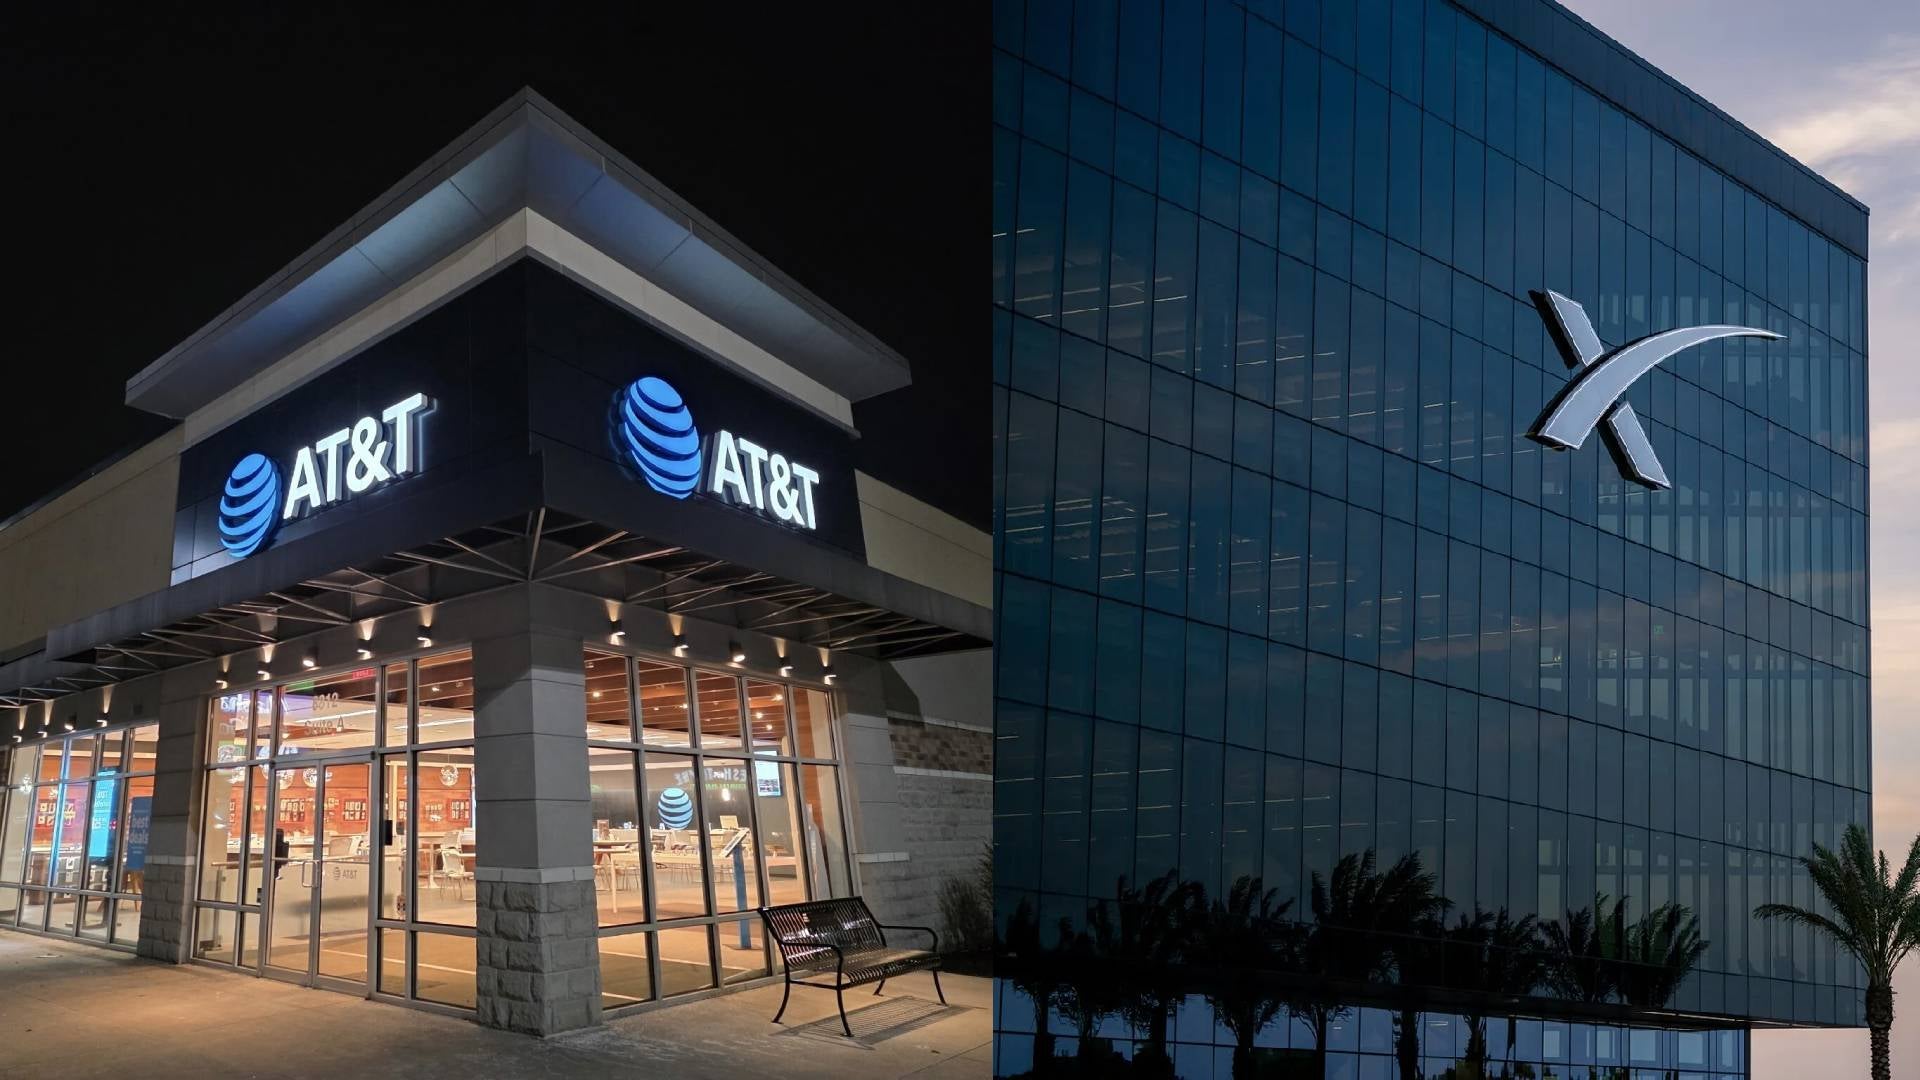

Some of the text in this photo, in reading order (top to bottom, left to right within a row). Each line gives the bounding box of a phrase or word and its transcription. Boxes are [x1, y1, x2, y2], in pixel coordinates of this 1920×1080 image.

[283, 392, 426, 520] AT&T
[711, 429, 820, 530] AT&T
[304, 715, 345, 737] Suite A
